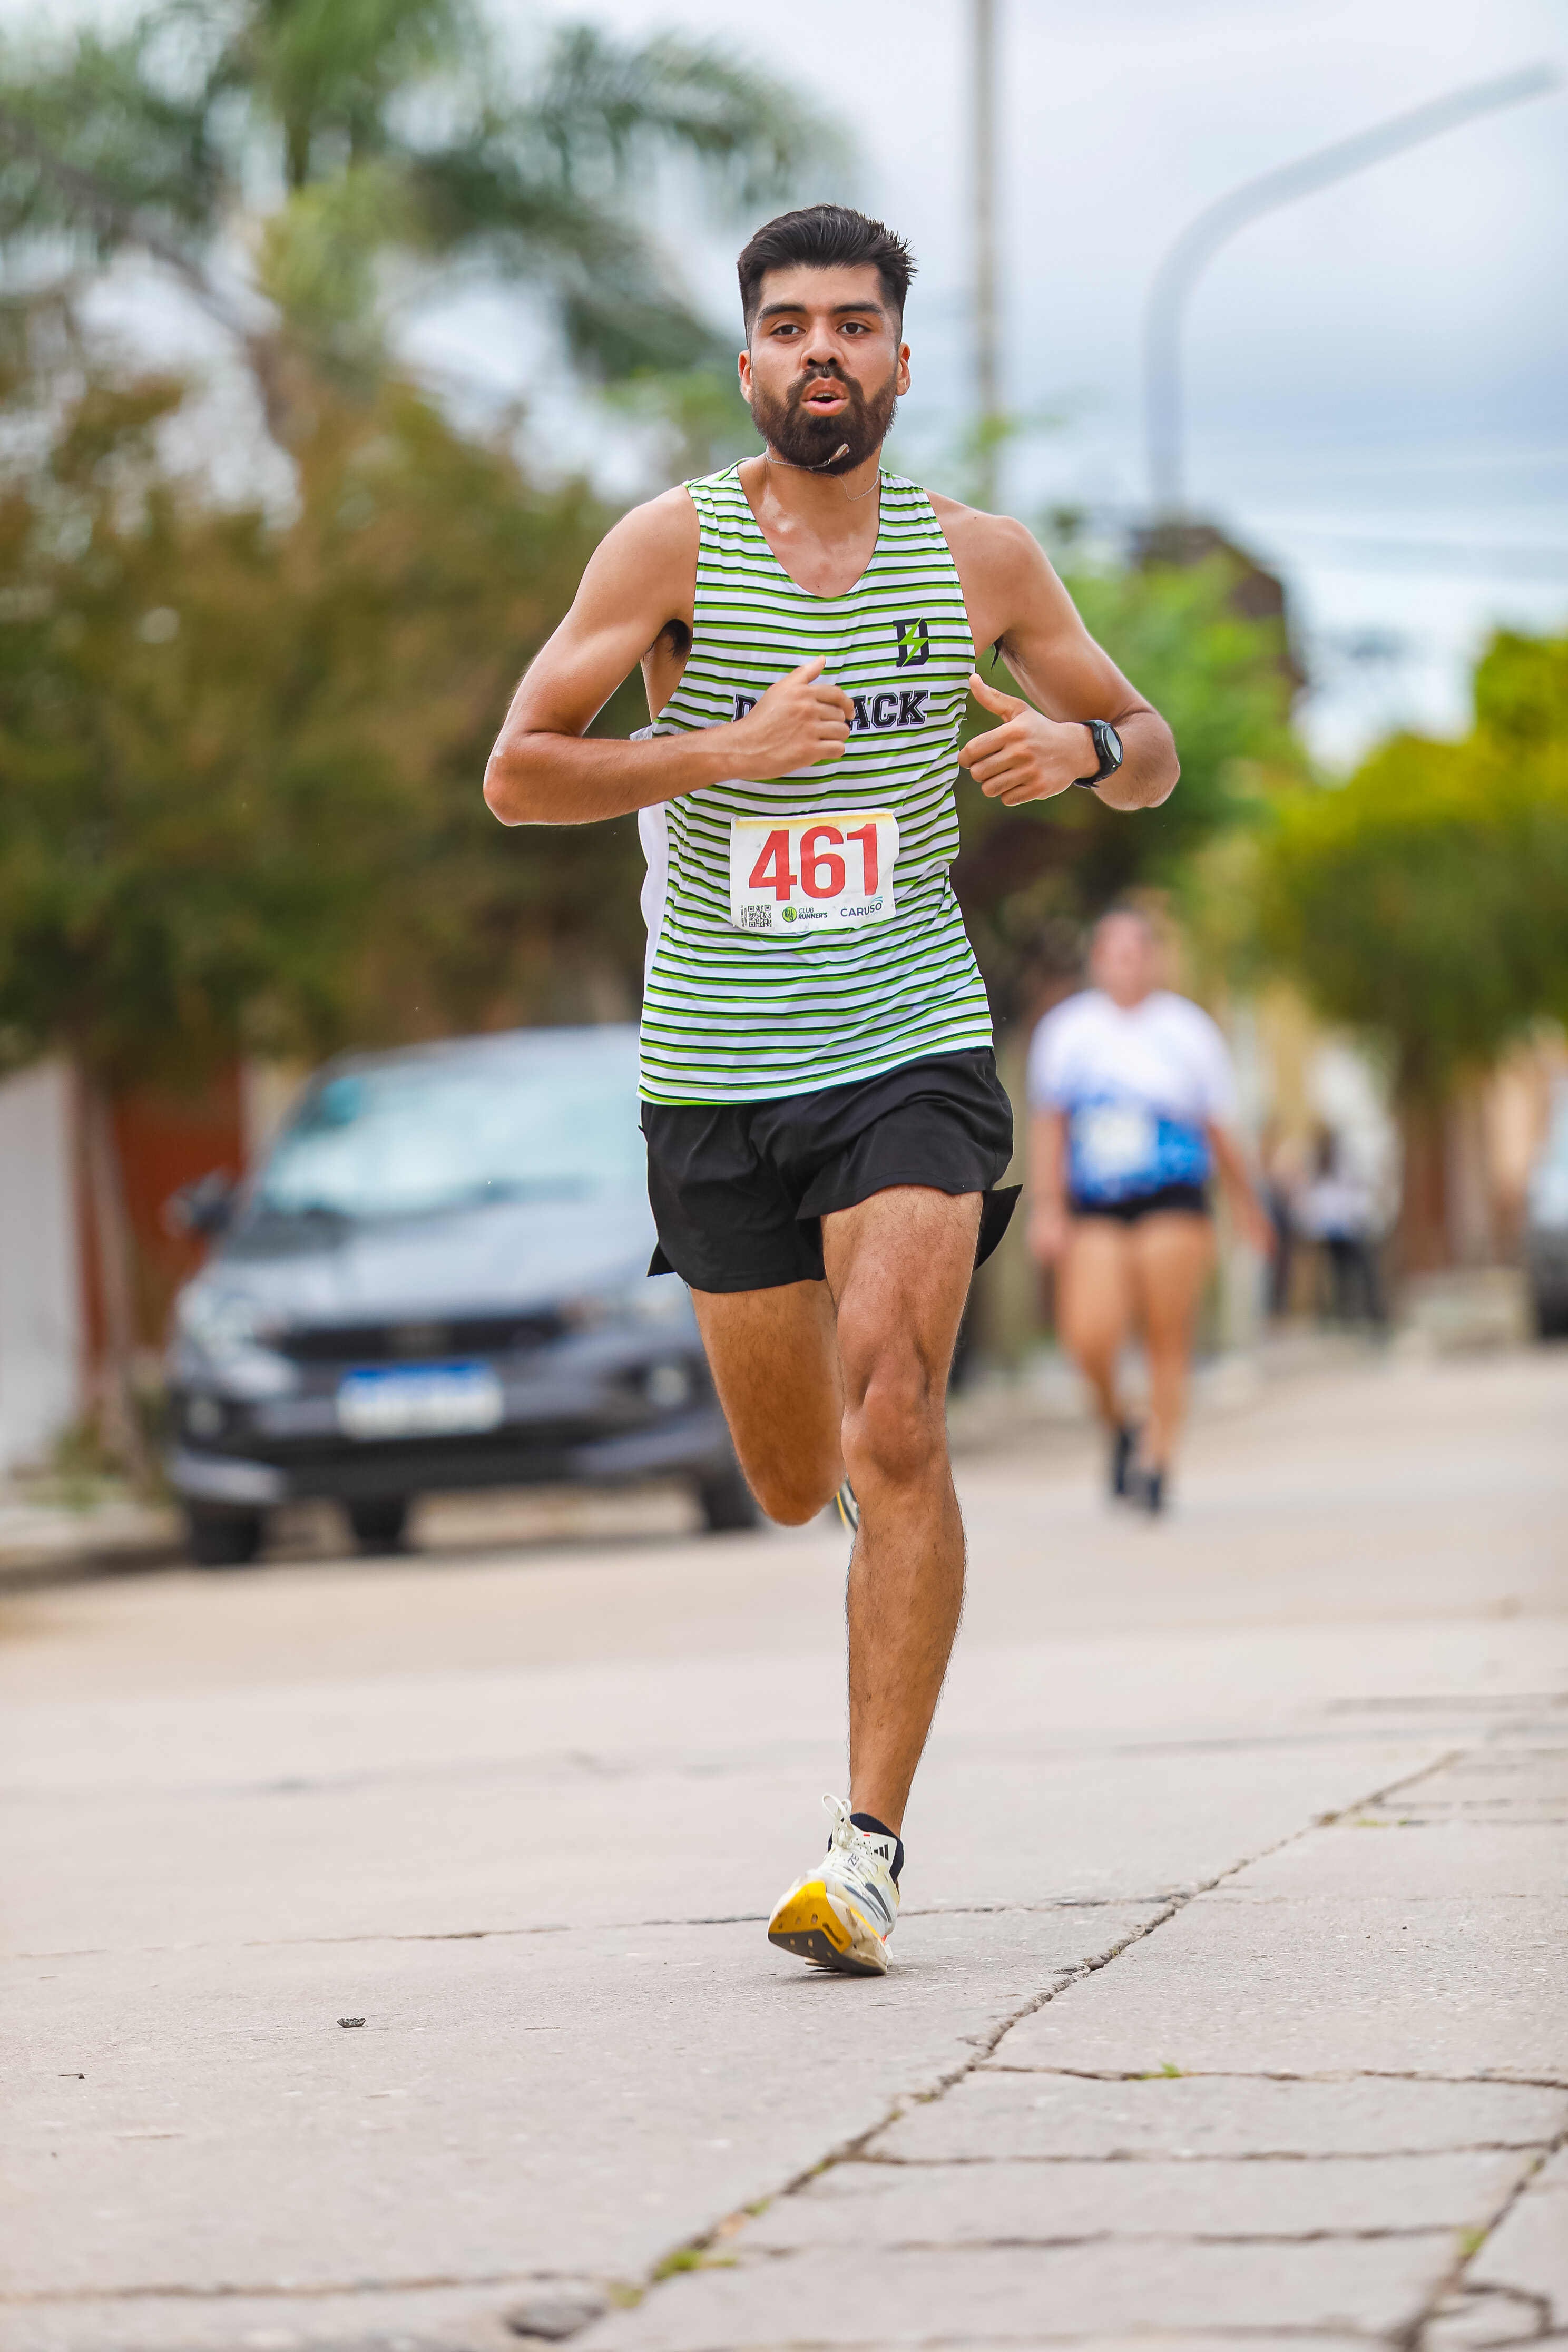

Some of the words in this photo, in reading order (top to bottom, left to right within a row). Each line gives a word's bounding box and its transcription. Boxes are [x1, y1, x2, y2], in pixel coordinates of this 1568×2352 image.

[748, 824, 878, 901] 461
[798, 912, 828, 920] RUNNER'S
[840, 902, 882, 917] CARUSO
